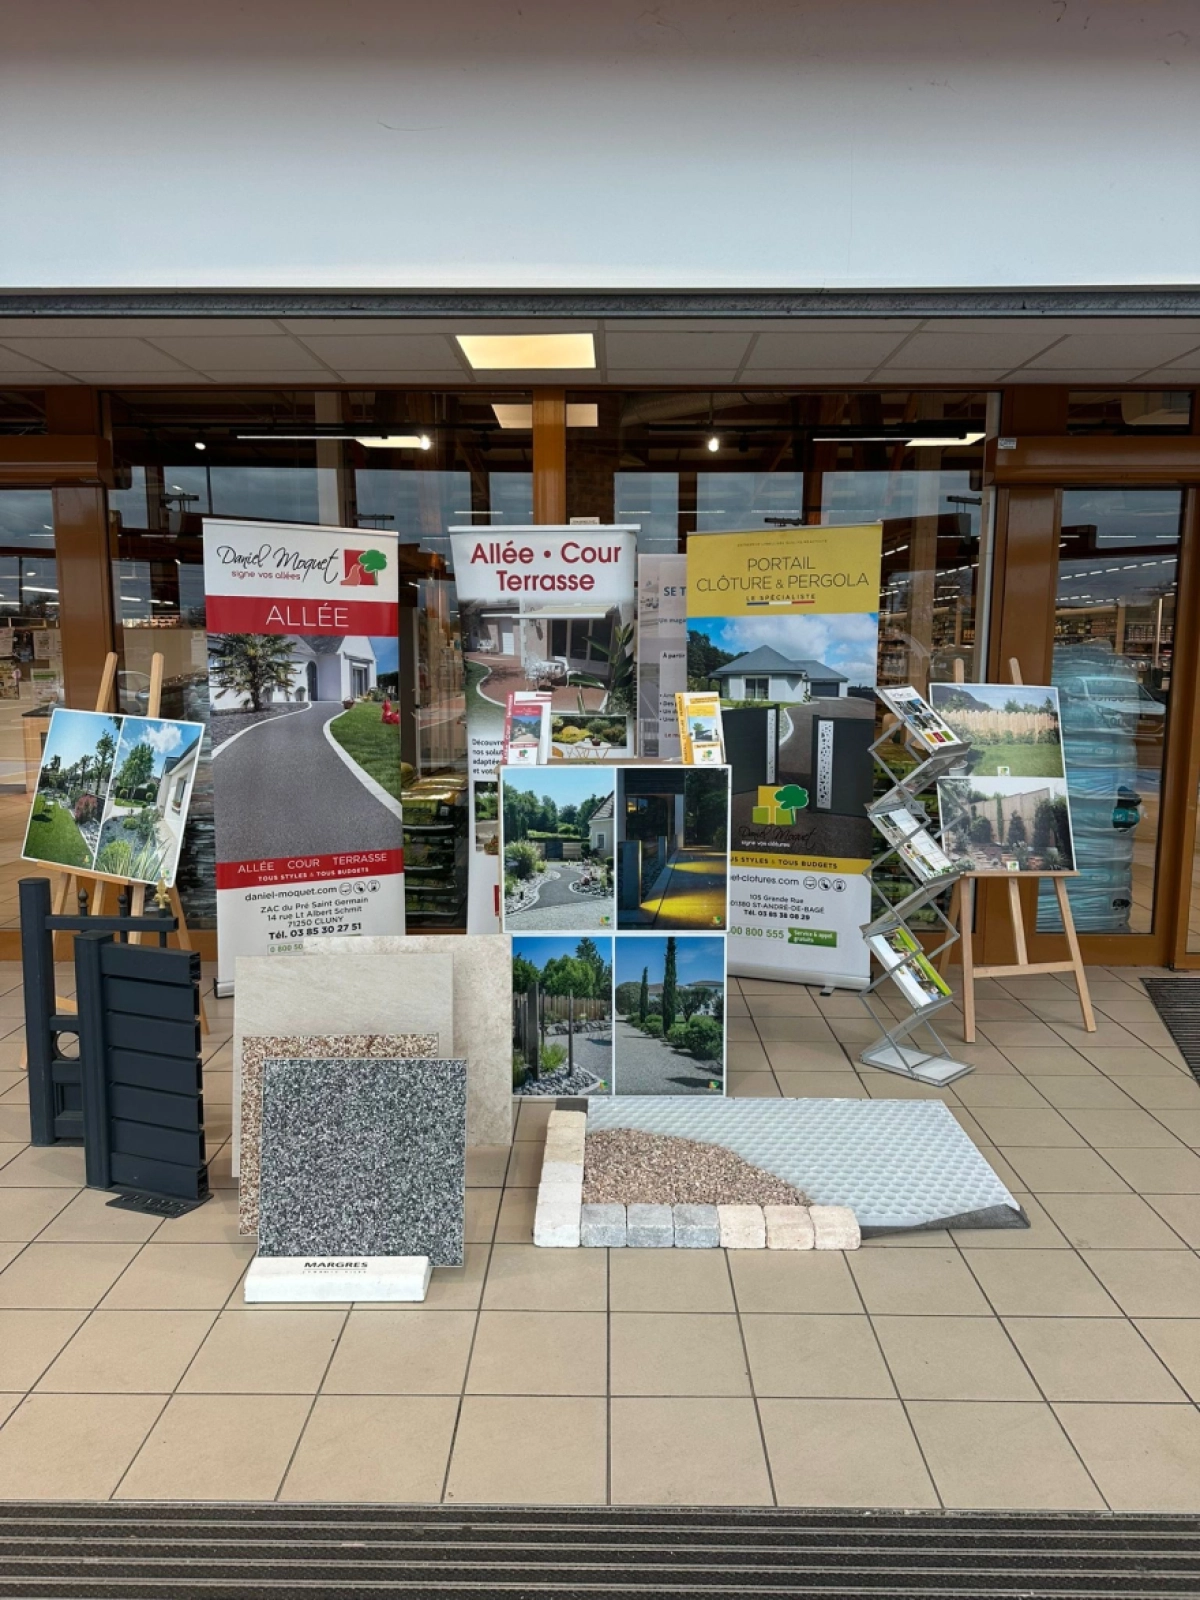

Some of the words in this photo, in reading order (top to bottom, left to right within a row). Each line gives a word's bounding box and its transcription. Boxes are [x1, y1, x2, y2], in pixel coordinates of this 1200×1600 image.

[471, 541, 535, 564] Allée
[561, 542, 622, 564] Cour
[217, 544, 272, 568] Daniel
[273, 547, 339, 584] Moquet
[747, 557, 816, 572] PORTAIL
[232, 570, 255, 580] signe
[259, 572, 273, 580] vos
[275, 570, 301, 581] allées
[496, 570, 595, 592] Terrasse
[697, 575, 772, 592] CLÔTURE
[775, 579, 784, 589] &
[788, 573, 869, 589] PERGOLA
[664, 587, 677, 597] SE
[266, 603, 349, 628] ALLÉE
[238, 861, 274, 874] ALLÉE
[288, 858, 320, 870] COUR
[333, 853, 388, 866] TERRASSE
[742, 857, 769, 865] STYLES
[801, 861, 838, 869] BUDGETS
[338, 867, 369, 876] BUDGETS
[245, 886, 337, 902] daniel-moquet.com
[764, 895, 789, 903] Grande
[260, 906, 280, 914] ZAC
[282, 904, 293, 912] du
[296, 902, 310, 910] Pré
[312, 899, 332, 909] Saint
[335, 896, 369, 907] Germain
[268, 914, 277, 922] 14
[307, 909, 332, 918] Albert
[335, 906, 362, 915] Schmit
[288, 919, 313, 928] 71250
[315, 916, 344, 925] CLUNY
[269, 931, 288, 940] Tél.
[291, 929, 304, 938] 03
[307, 927, 319, 937] 85
[322, 925, 335, 935] 30
[337, 924, 350, 933] 27
[352, 922, 362, 931] 51
[746, 927, 763, 937] 800
[766, 929, 785, 939] 555
